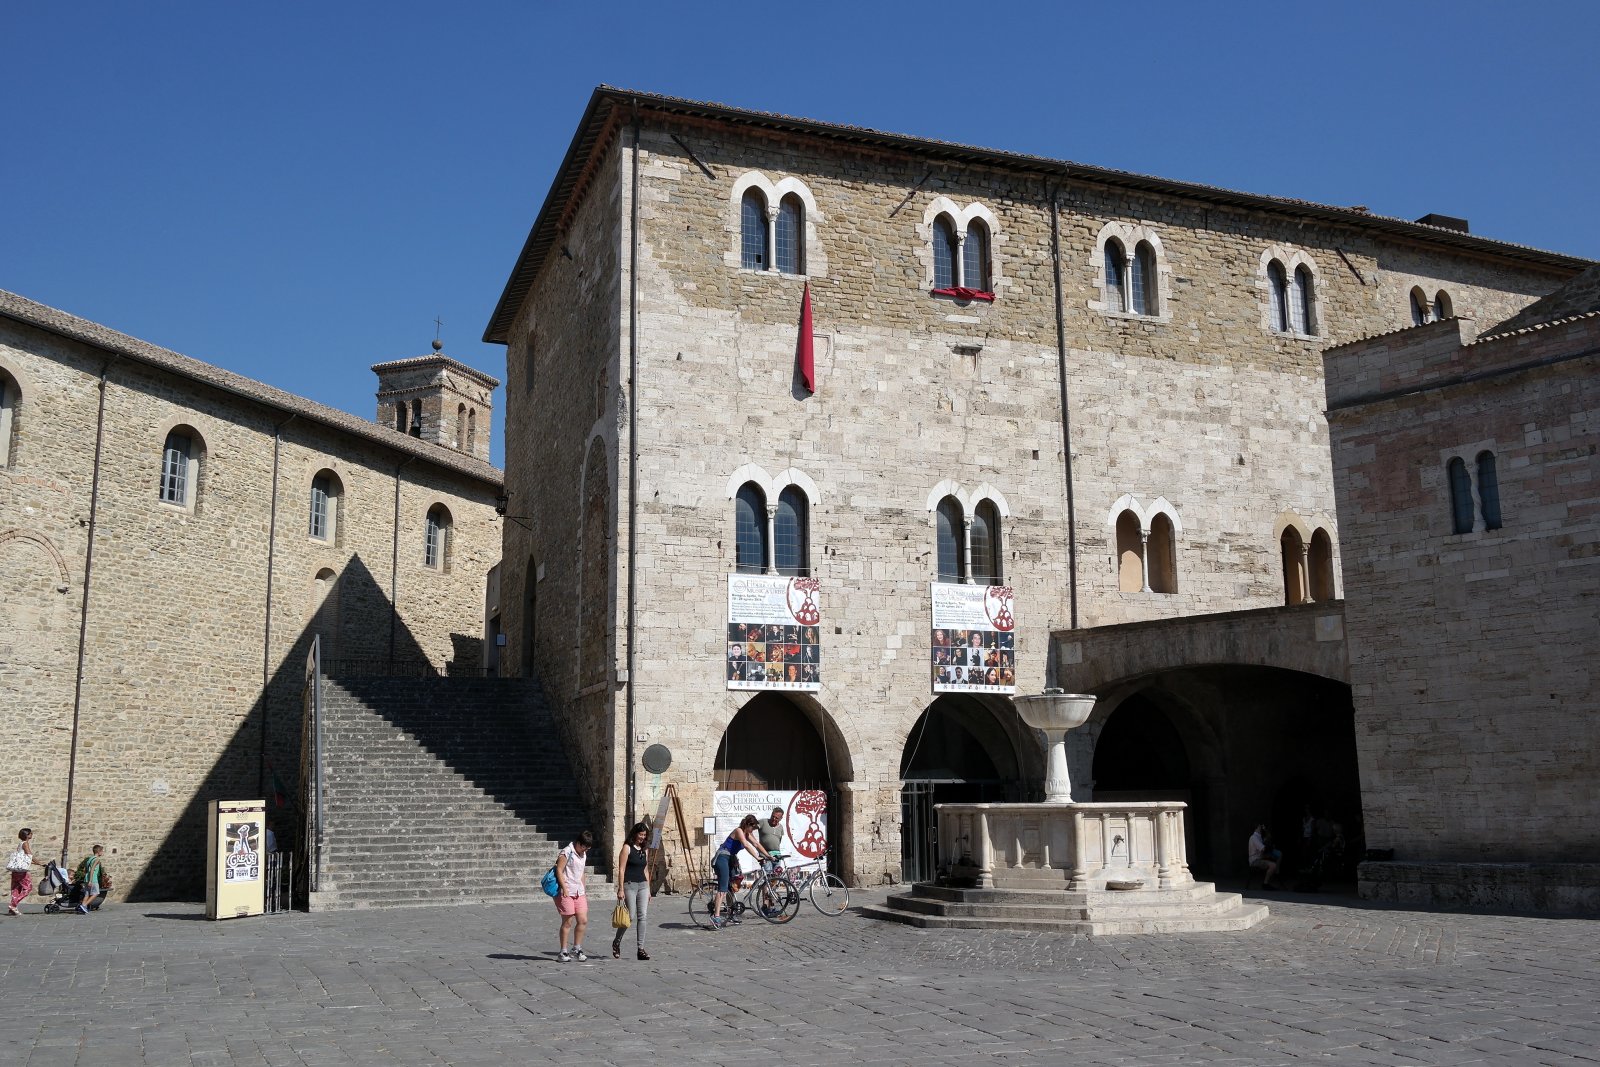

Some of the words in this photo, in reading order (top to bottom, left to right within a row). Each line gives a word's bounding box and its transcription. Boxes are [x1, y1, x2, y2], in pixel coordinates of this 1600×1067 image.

[733, 794, 765, 804] FEDERICO
[766, 793, 782, 804] CESI
[228, 852, 257, 867] GREASE
